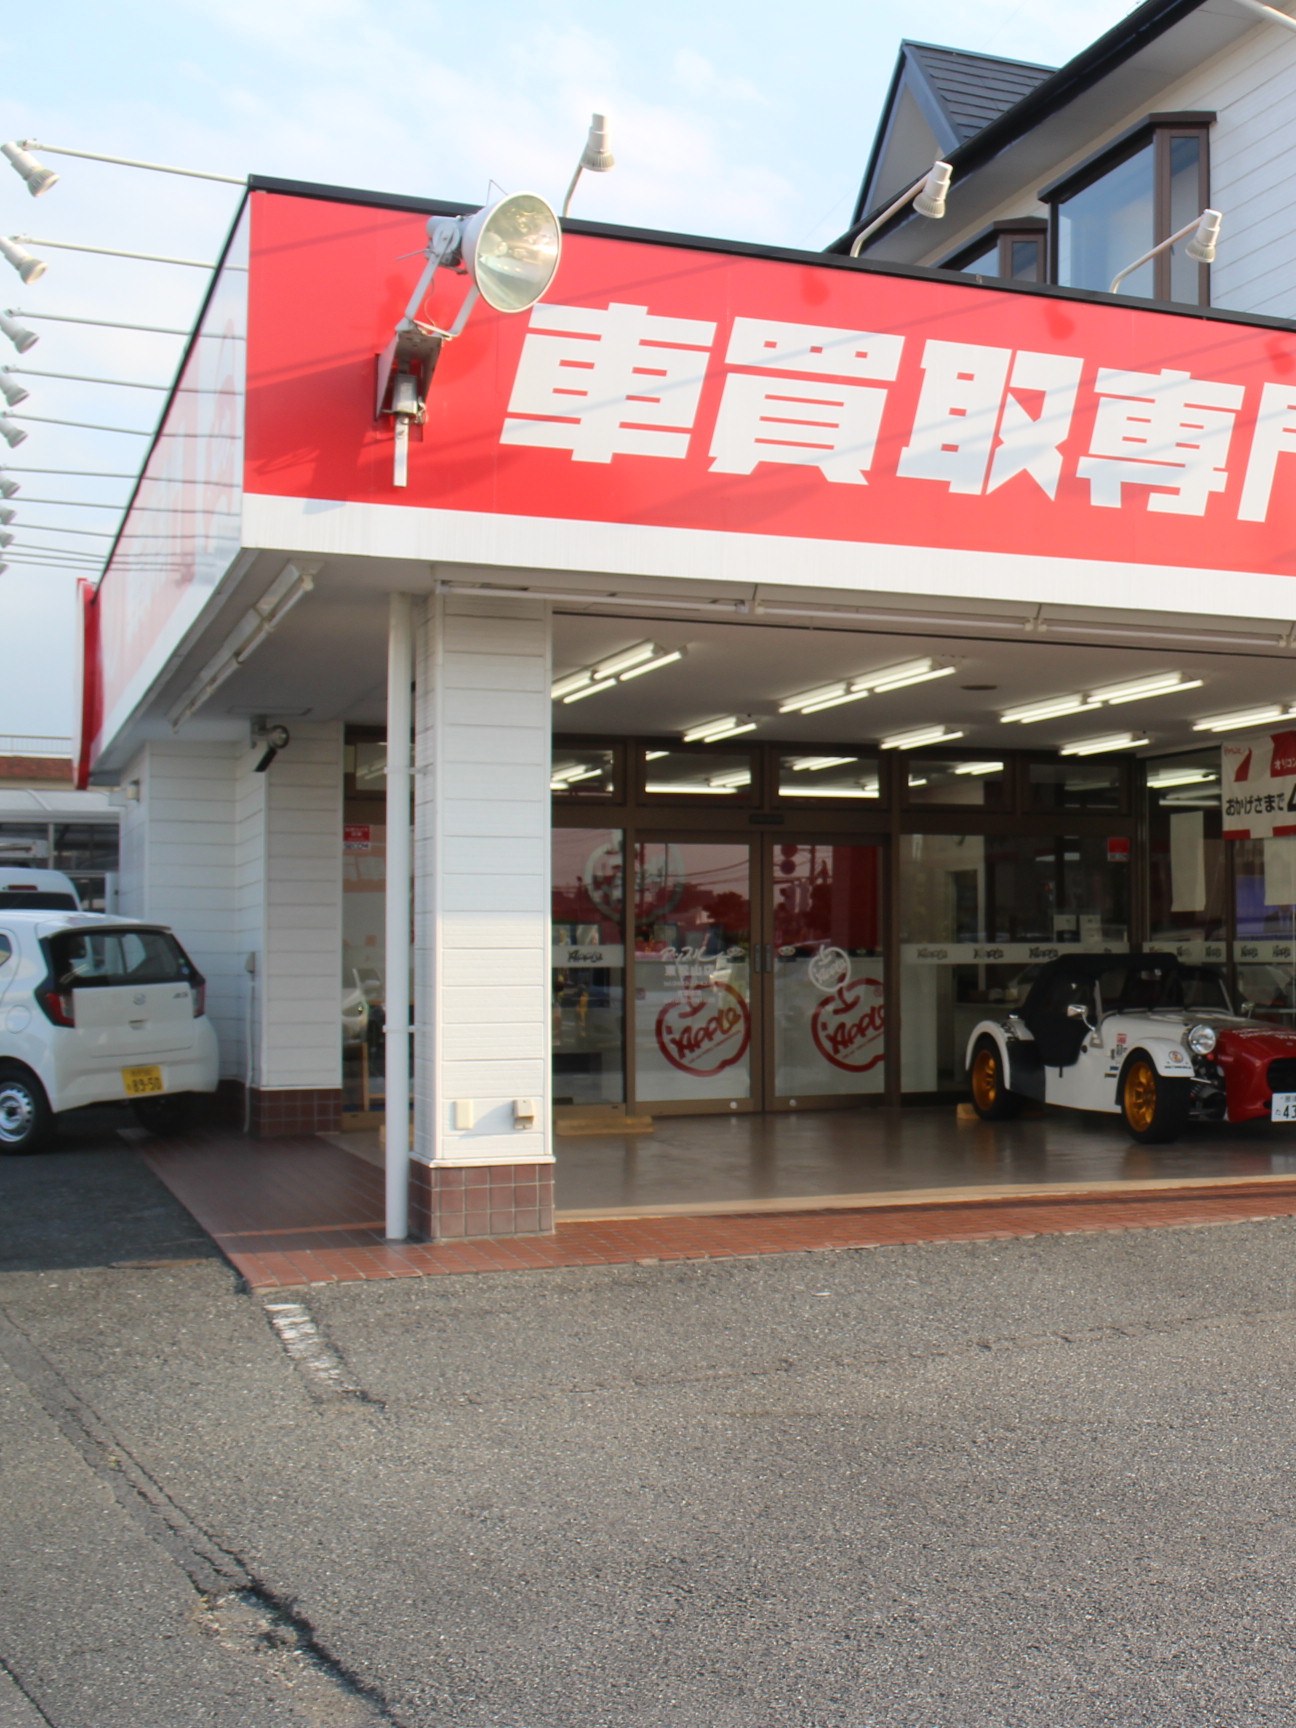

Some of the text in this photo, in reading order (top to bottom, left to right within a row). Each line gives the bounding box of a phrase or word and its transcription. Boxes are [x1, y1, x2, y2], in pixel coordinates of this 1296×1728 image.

[1225, 792, 1286, 817] おかげさまで
[669, 1007, 742, 1060] Apple
